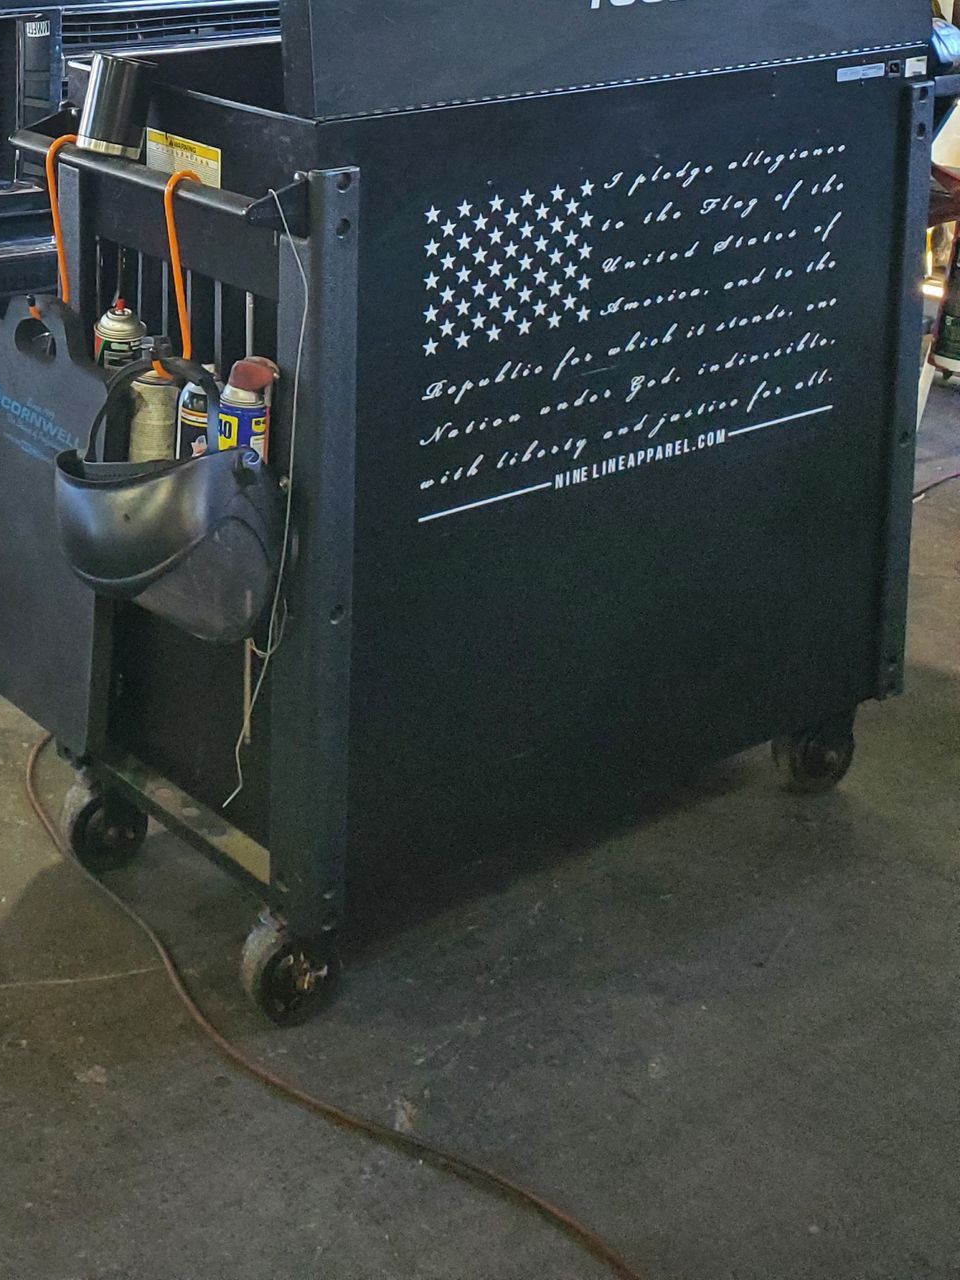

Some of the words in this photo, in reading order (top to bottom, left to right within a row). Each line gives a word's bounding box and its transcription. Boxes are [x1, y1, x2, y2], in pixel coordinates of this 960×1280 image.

[173, 140, 197, 154] WARNING
[604, 172, 623, 188] I
[628, 162, 712, 196] pledge
[728, 145, 845, 173] allegiance
[602, 219, 624, 231] to
[644, 202, 681, 224] the
[700, 195, 757, 218] Flag
[775, 180, 803, 210] of
[812, 174, 843, 194] the
[602, 241, 699, 272] United
[713, 230, 796, 254] States
[814, 212, 841, 241] of
[724, 268, 766, 289] and
[775, 268, 792, 279] to
[807, 252, 835, 272] the
[422, 361, 542, 404] Republic
[553, 347, 592, 380] for
[608, 324, 677, 355] which
[807, 298, 836, 311] one
[1, 395, 80, 449] CORNWELL
[420, 414, 520, 445] Nation
[540, 389, 610, 414] under
[420, 455, 483, 489] with
[497, 439, 586, 468] liberty
[603, 415, 648, 439] and
[648, 398, 738, 438] justice
[747, 381, 781, 412] for
